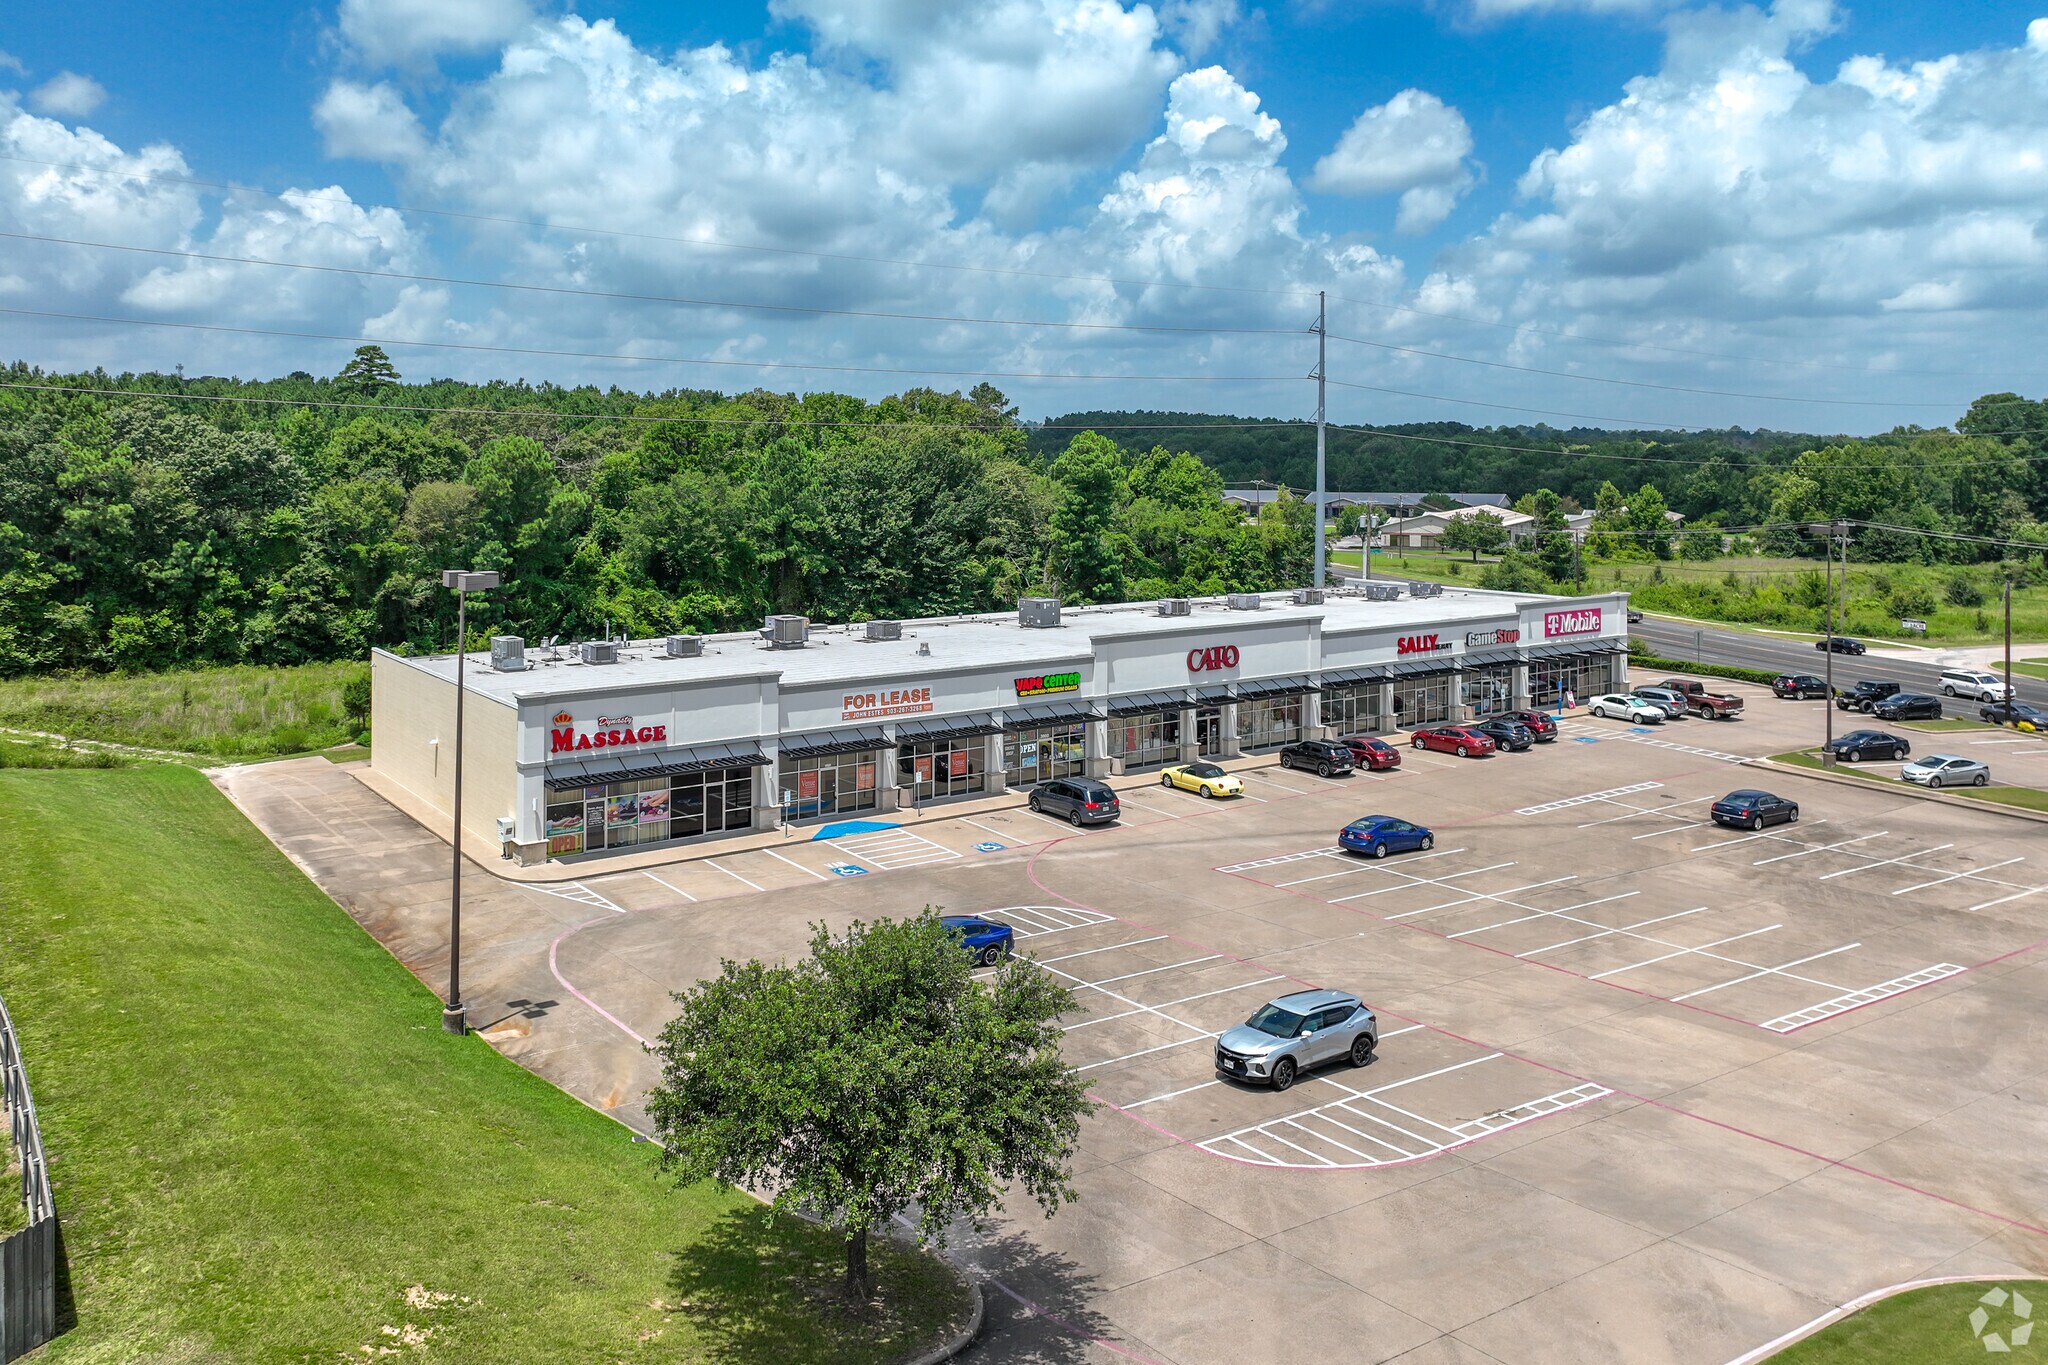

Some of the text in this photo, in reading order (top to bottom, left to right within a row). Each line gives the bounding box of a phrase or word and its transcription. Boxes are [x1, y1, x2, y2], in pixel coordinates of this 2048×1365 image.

[1397, 634, 1439, 655] SALLY
[1467, 629, 1520, 647] GameStop
[1187, 645, 1240, 672] CATO
[843, 688, 931, 710] FOR LEASE
[598, 715, 633, 727] Dynasty
[852, 711, 867, 719] JOHN
[868, 709, 884, 717] ESTES
[551, 725, 667, 753] MASSAGE
